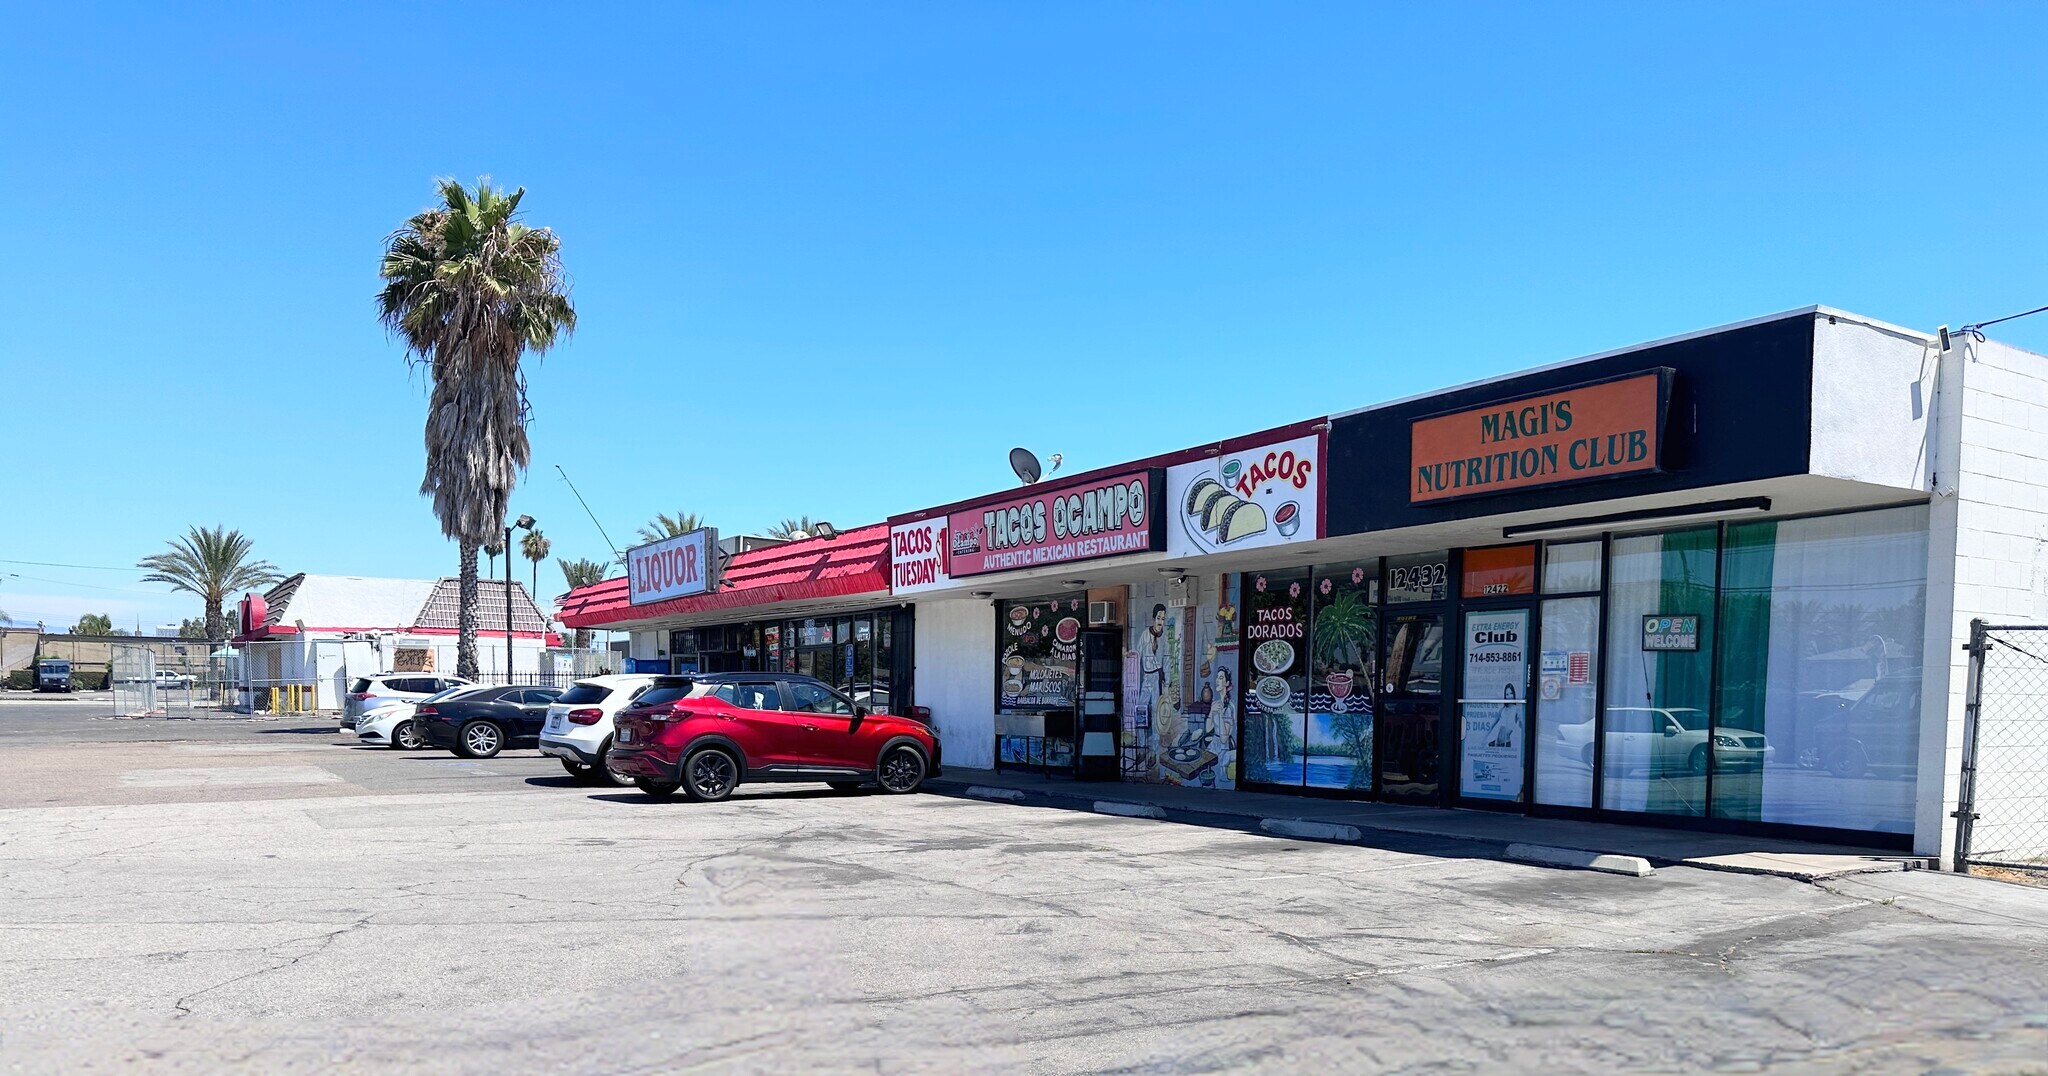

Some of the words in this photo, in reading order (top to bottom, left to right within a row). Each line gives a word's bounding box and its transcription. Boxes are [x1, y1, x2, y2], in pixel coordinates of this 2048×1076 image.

[1481, 400, 1573, 444] MAGI'S
[1417, 444, 1559, 494] NUTRITION
[1568, 429, 1648, 471] CLUB
[1236, 450, 1312, 498] TACOS
[983, 500, 1047, 551] TACOS
[1053, 478, 1147, 540] OCAMPO
[893, 526, 932, 557] TACOS
[894, 557, 936, 587] TUESDAY
[936, 527, 949, 575] $1
[983, 550, 1032, 570] AUTHENTIC
[1033, 543, 1075, 562] MEXICAN
[1077, 530, 1148, 557] RESTAURANT
[636, 543, 698, 593] LIQUOR
[1389, 563, 1446, 590] 12432
[1483, 584, 1509, 595] 12422
[1257, 607, 1293, 622] TACOS
[1007, 621, 1032, 636] MENUDO
[1247, 622, 1303, 639] DORADOS
[1472, 623, 1492, 631] EXTRA
[1493, 621, 1520, 631] ENERGY
[1645, 618, 1696, 633] OPEN
[1475, 630, 1517, 643] Club
[1645, 634, 1695, 648] WELCOME
[1002, 642, 1018, 665] POZOLE
[1469, 652, 1521, 662] 714-553-8861
[1029, 669, 1063, 680] MOLCAJETES
[1029, 681, 1062, 693] MARISCOS
[1466, 722, 1470, 731] 3
[1473, 722, 1490, 731] DIAS
